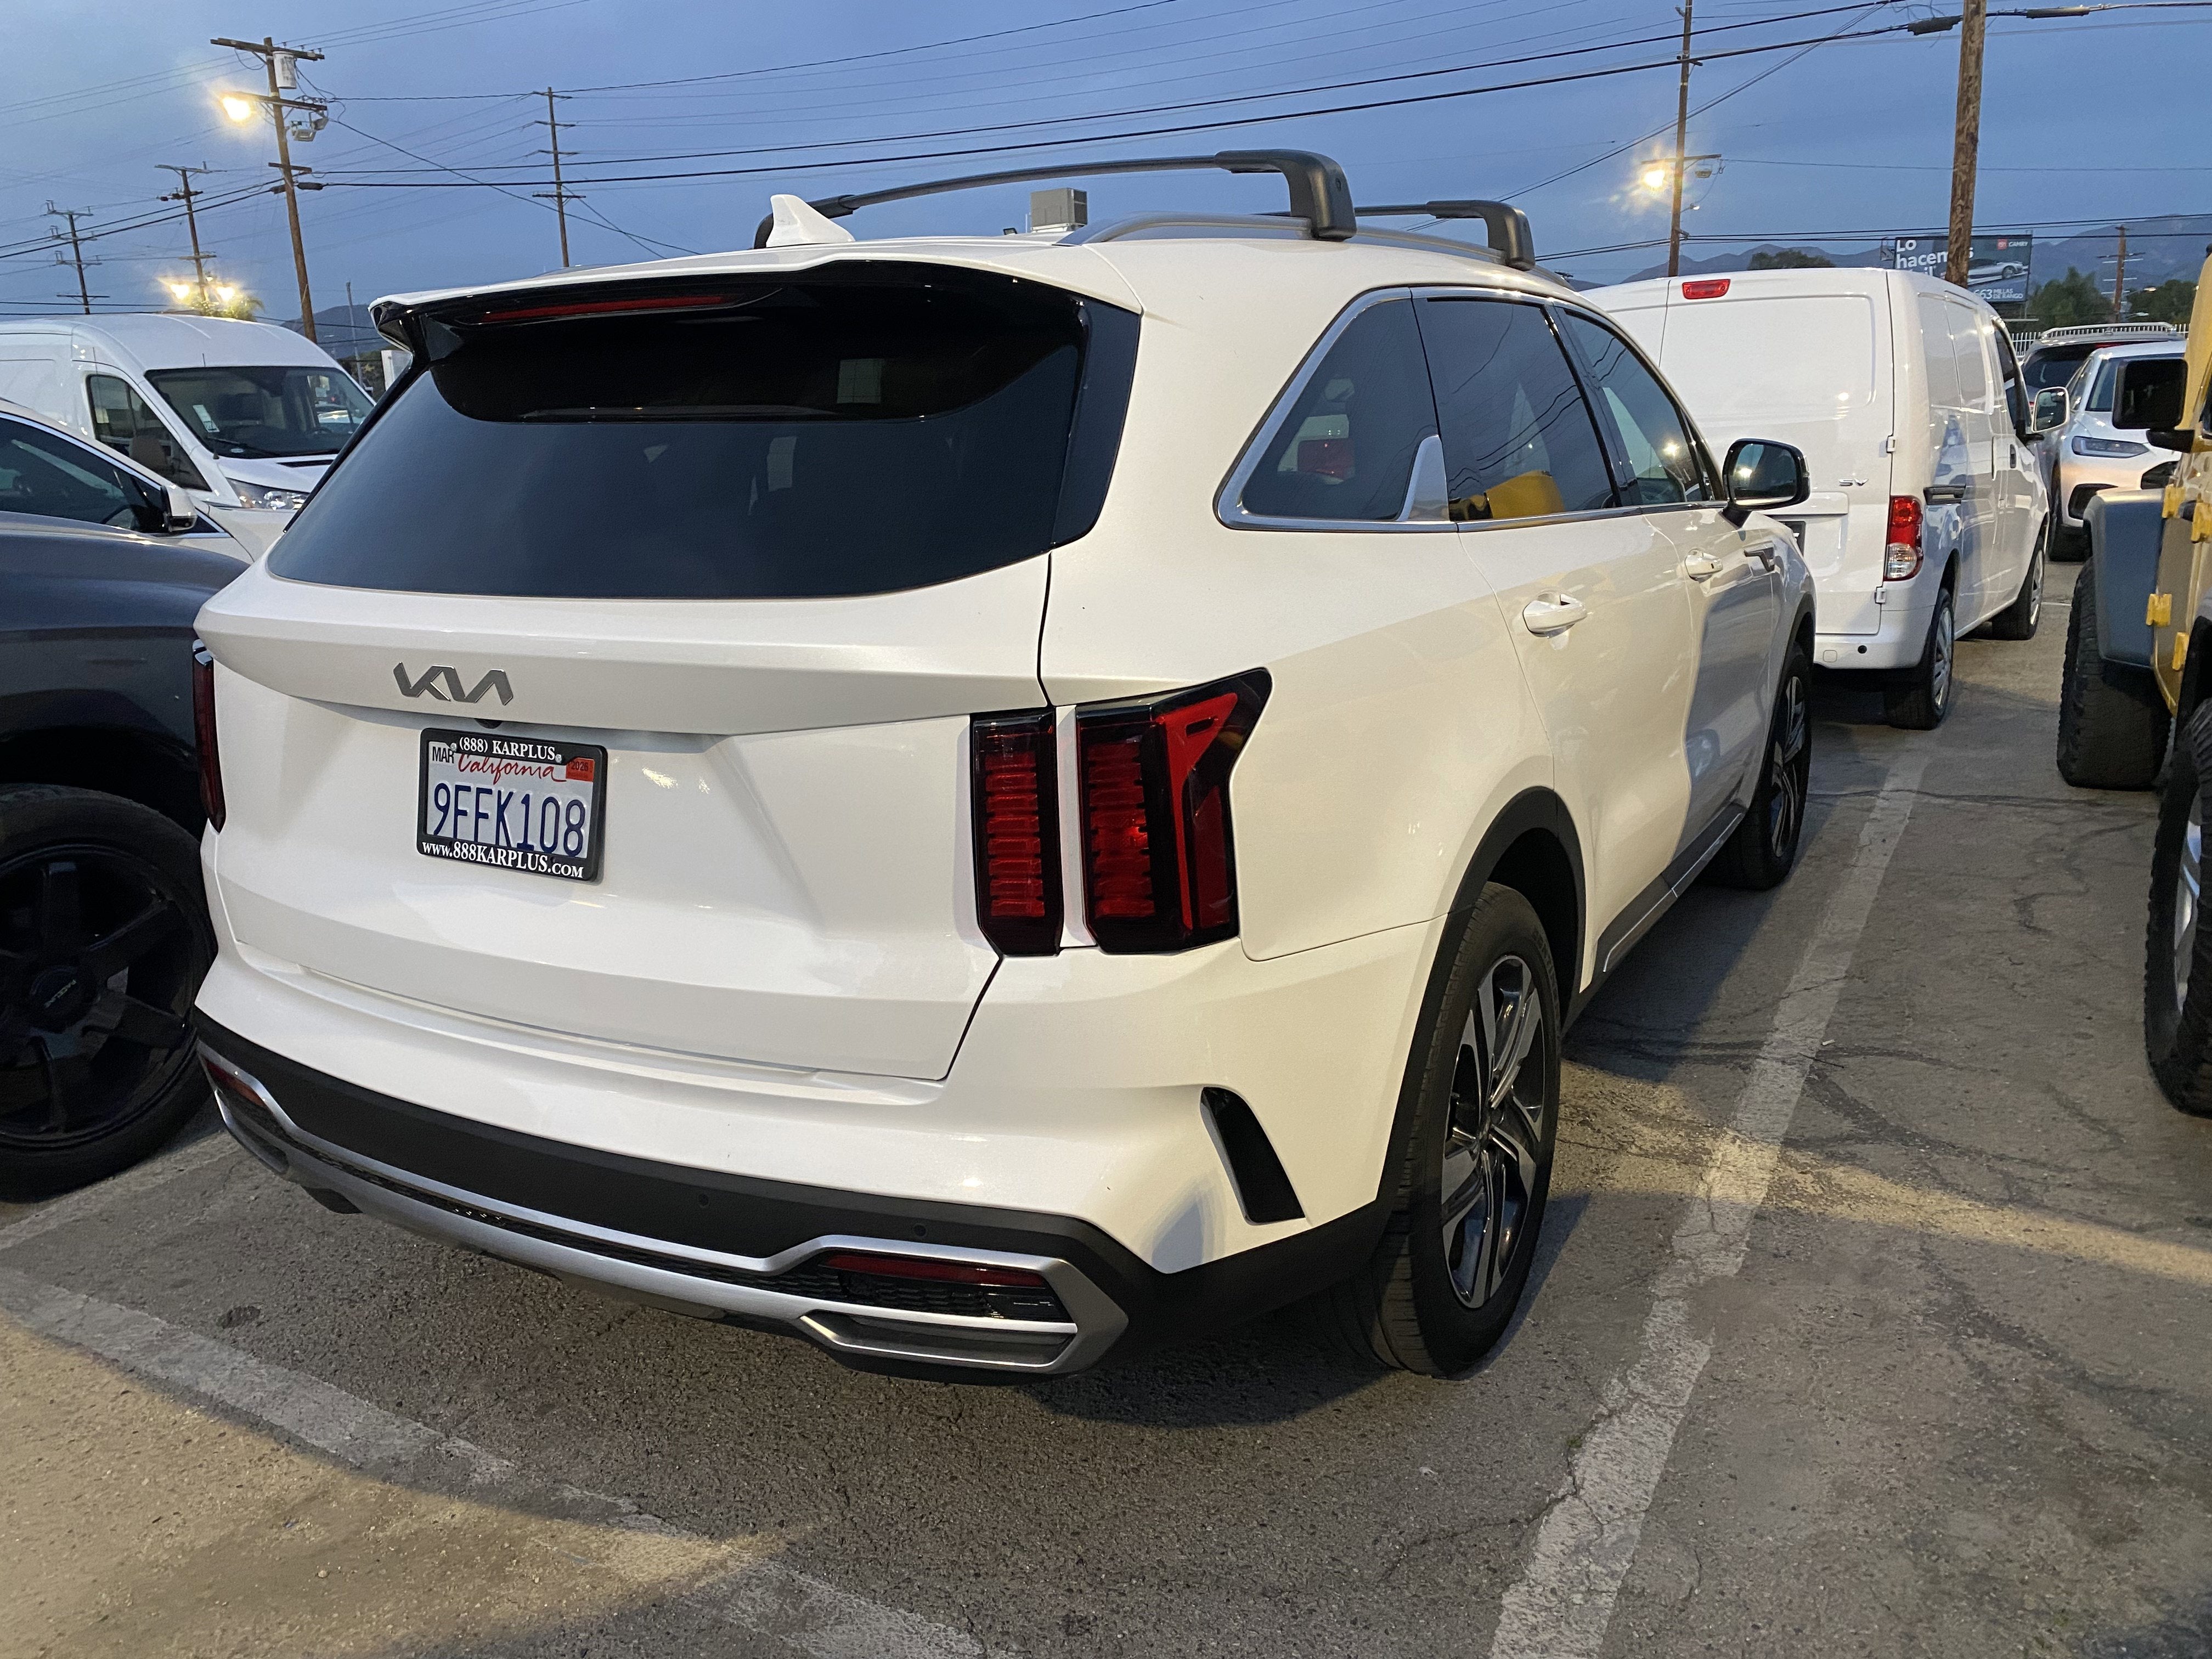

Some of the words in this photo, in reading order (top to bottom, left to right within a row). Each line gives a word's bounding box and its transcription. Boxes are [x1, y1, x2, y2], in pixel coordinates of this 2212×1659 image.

[1897, 239, 1916, 252] Lo
[1839, 478, 1869, 487] SV
[393, 662, 514, 706] KIA
[432, 746, 455, 764] MAR
[459, 737, 488, 753] (888)
[492, 740, 556, 760] KARPLUS
[458, 753, 567, 785] California
[571, 761, 589, 771] 2026
[434, 783, 585, 857] 9FFK108
